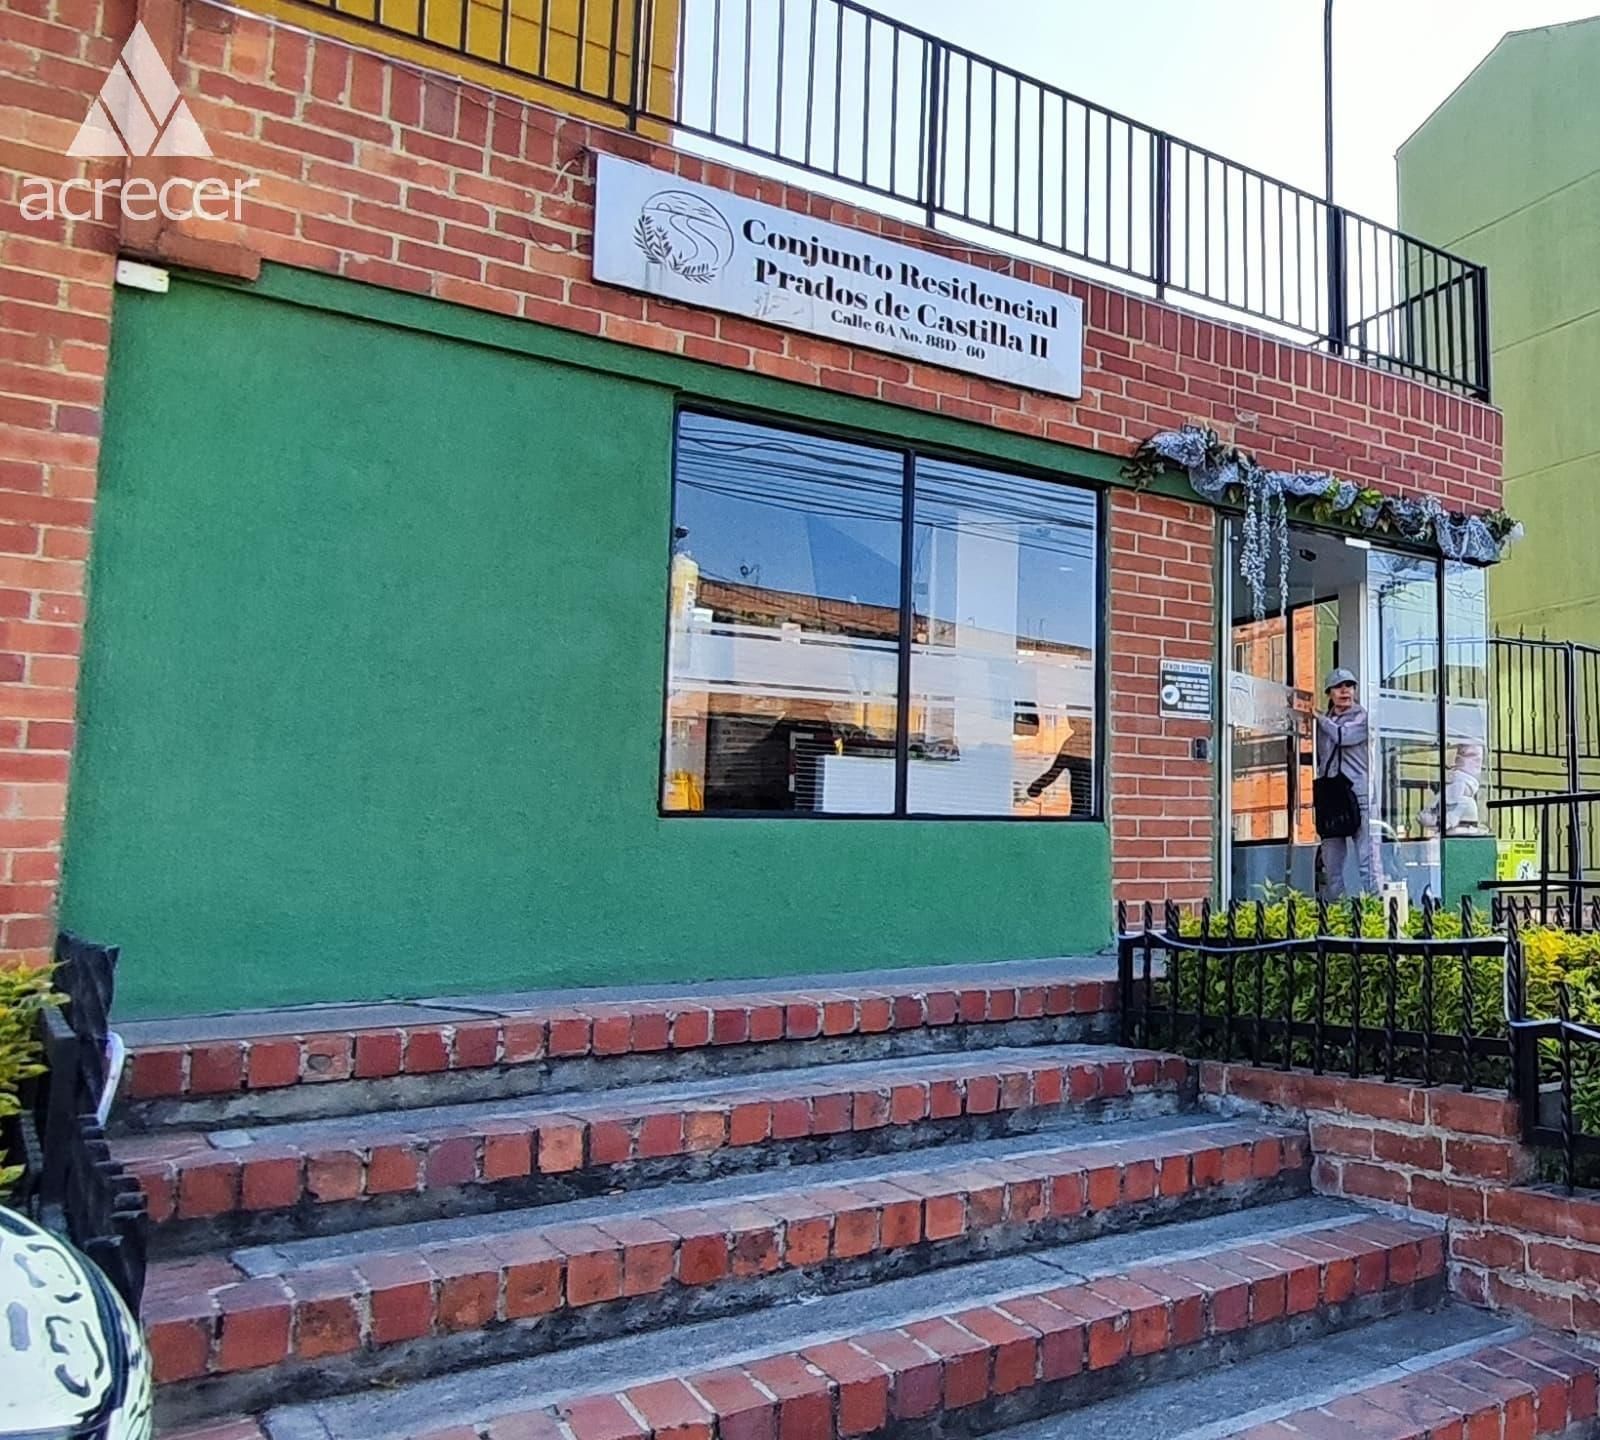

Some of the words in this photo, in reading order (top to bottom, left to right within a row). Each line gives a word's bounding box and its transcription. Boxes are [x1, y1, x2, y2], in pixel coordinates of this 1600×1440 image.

[743, 219, 893, 281] Conjunto
[900, 262, 1058, 329] Residencial
[754, 257, 868, 311] Prados
[875, 291, 910, 321] de
[918, 304, 1024, 353] Castilla
[1030, 333, 1049, 359] II
[831, 309, 872, 330] Calle
[875, 321, 896, 338] 6A
[899, 326, 922, 345] No.
[925, 334, 957, 352] 88D
[966, 345, 986, 360] 60
